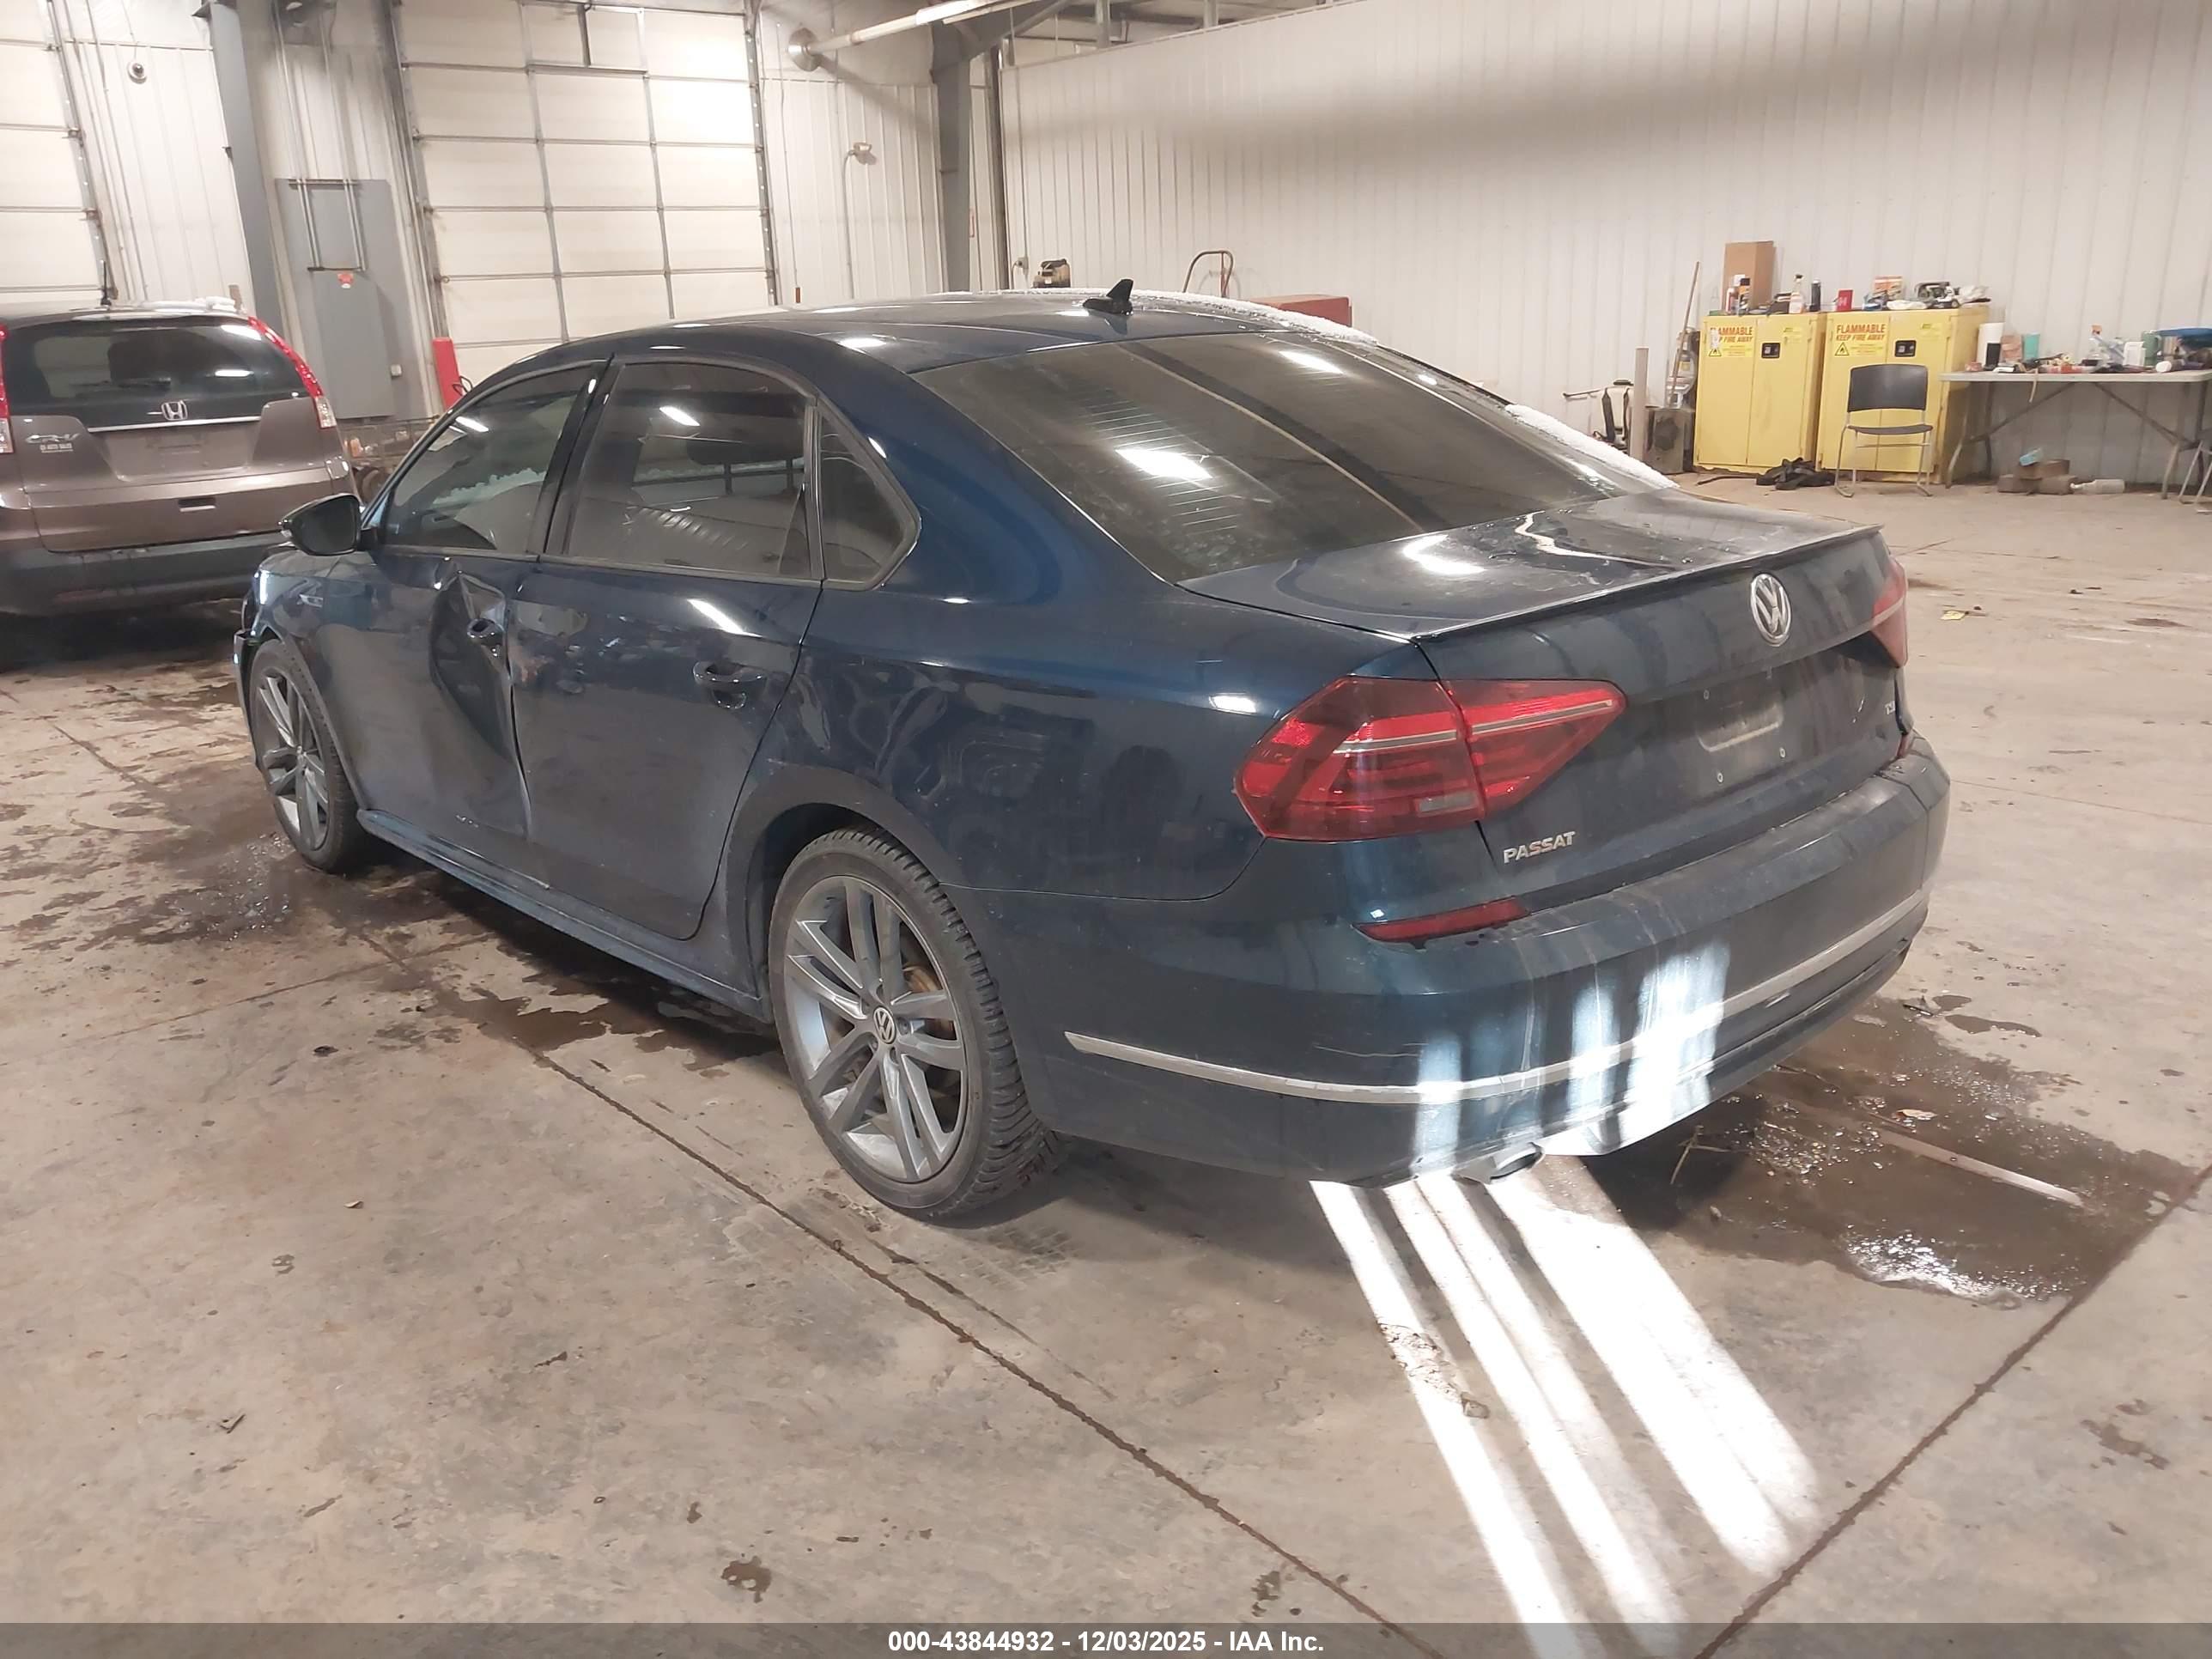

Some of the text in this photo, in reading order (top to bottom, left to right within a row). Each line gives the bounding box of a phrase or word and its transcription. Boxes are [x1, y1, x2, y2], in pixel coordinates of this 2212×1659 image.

[1710, 326, 1753, 336] AMMABLE
[1836, 324, 1886, 333] FLAMMABLE
[1504, 830, 1576, 864] PASSAT
